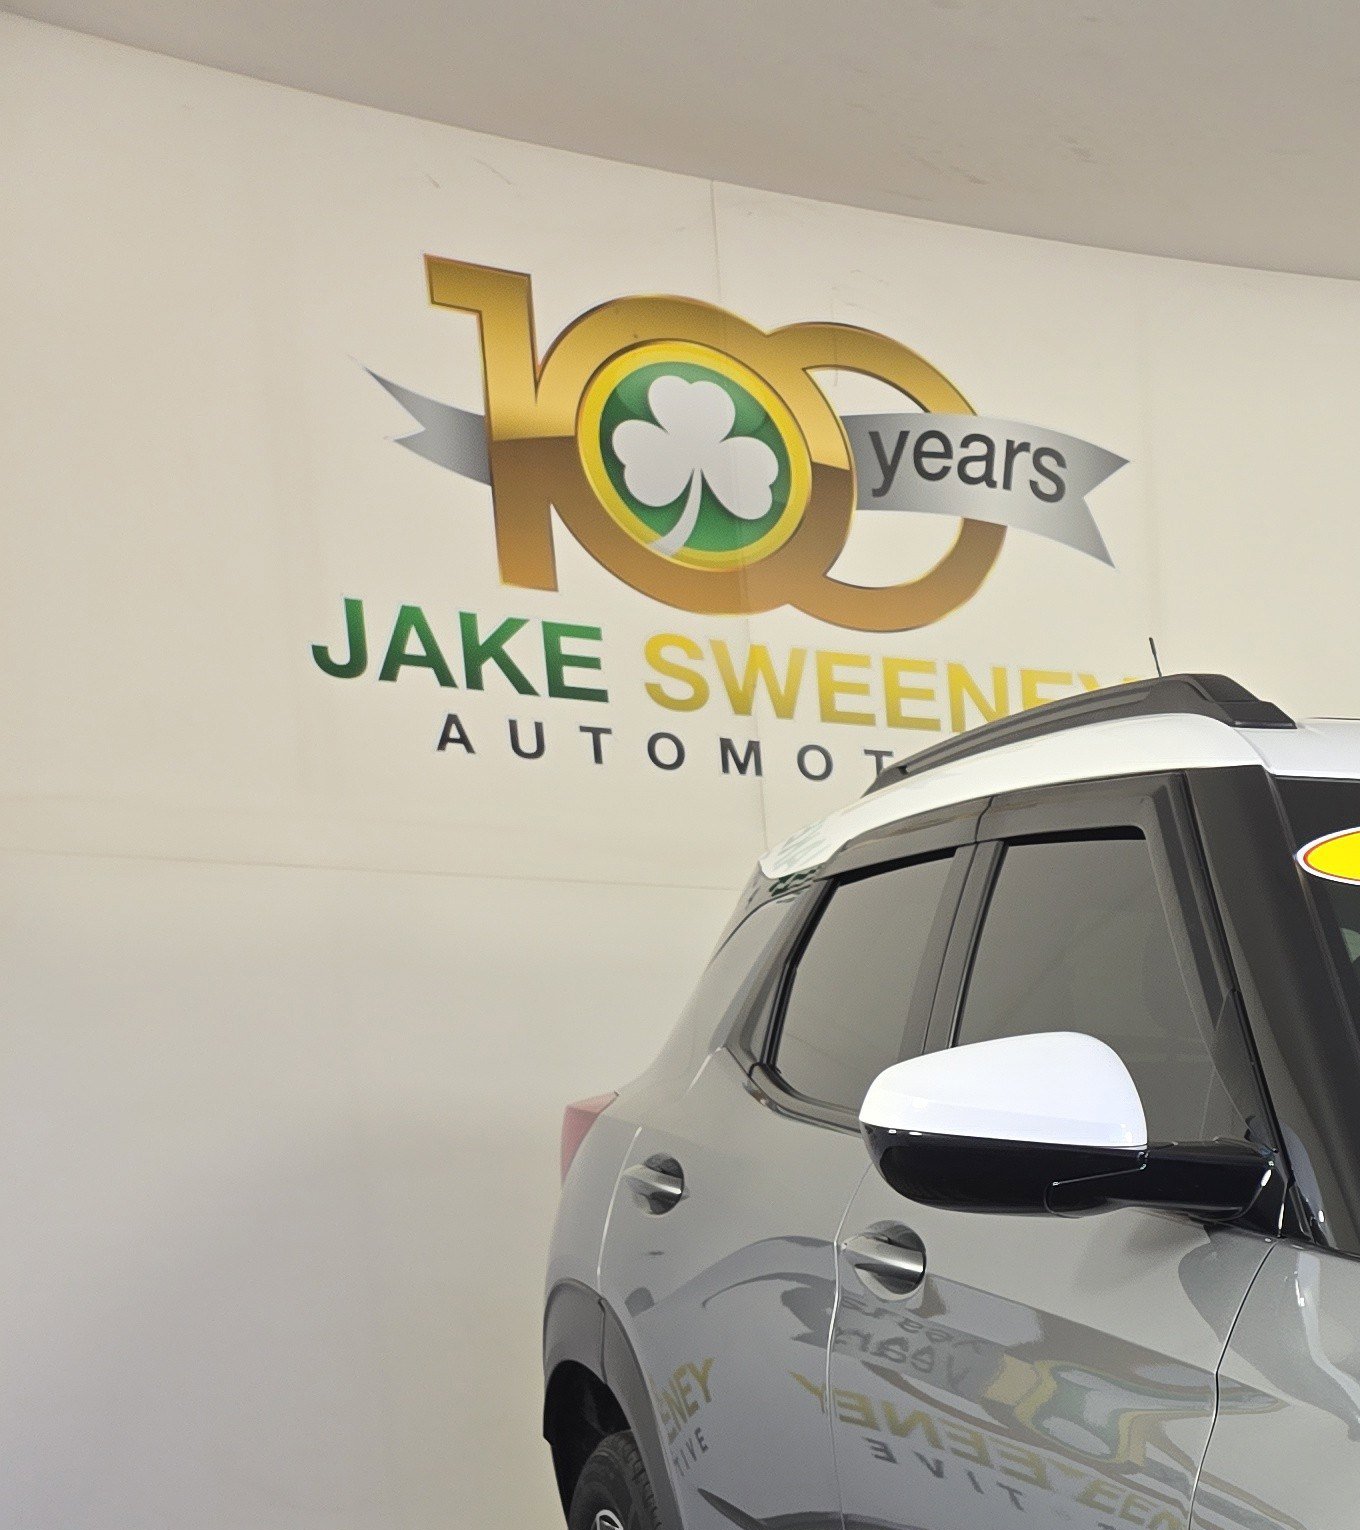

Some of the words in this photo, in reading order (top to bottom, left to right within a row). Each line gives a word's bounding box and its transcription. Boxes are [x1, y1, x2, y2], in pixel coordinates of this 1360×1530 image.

[423, 253, 1008, 632] 100
[869, 428, 1068, 504] years
[311, 597, 610, 704] JAKE
[644, 632, 1137, 733] SWEENE
